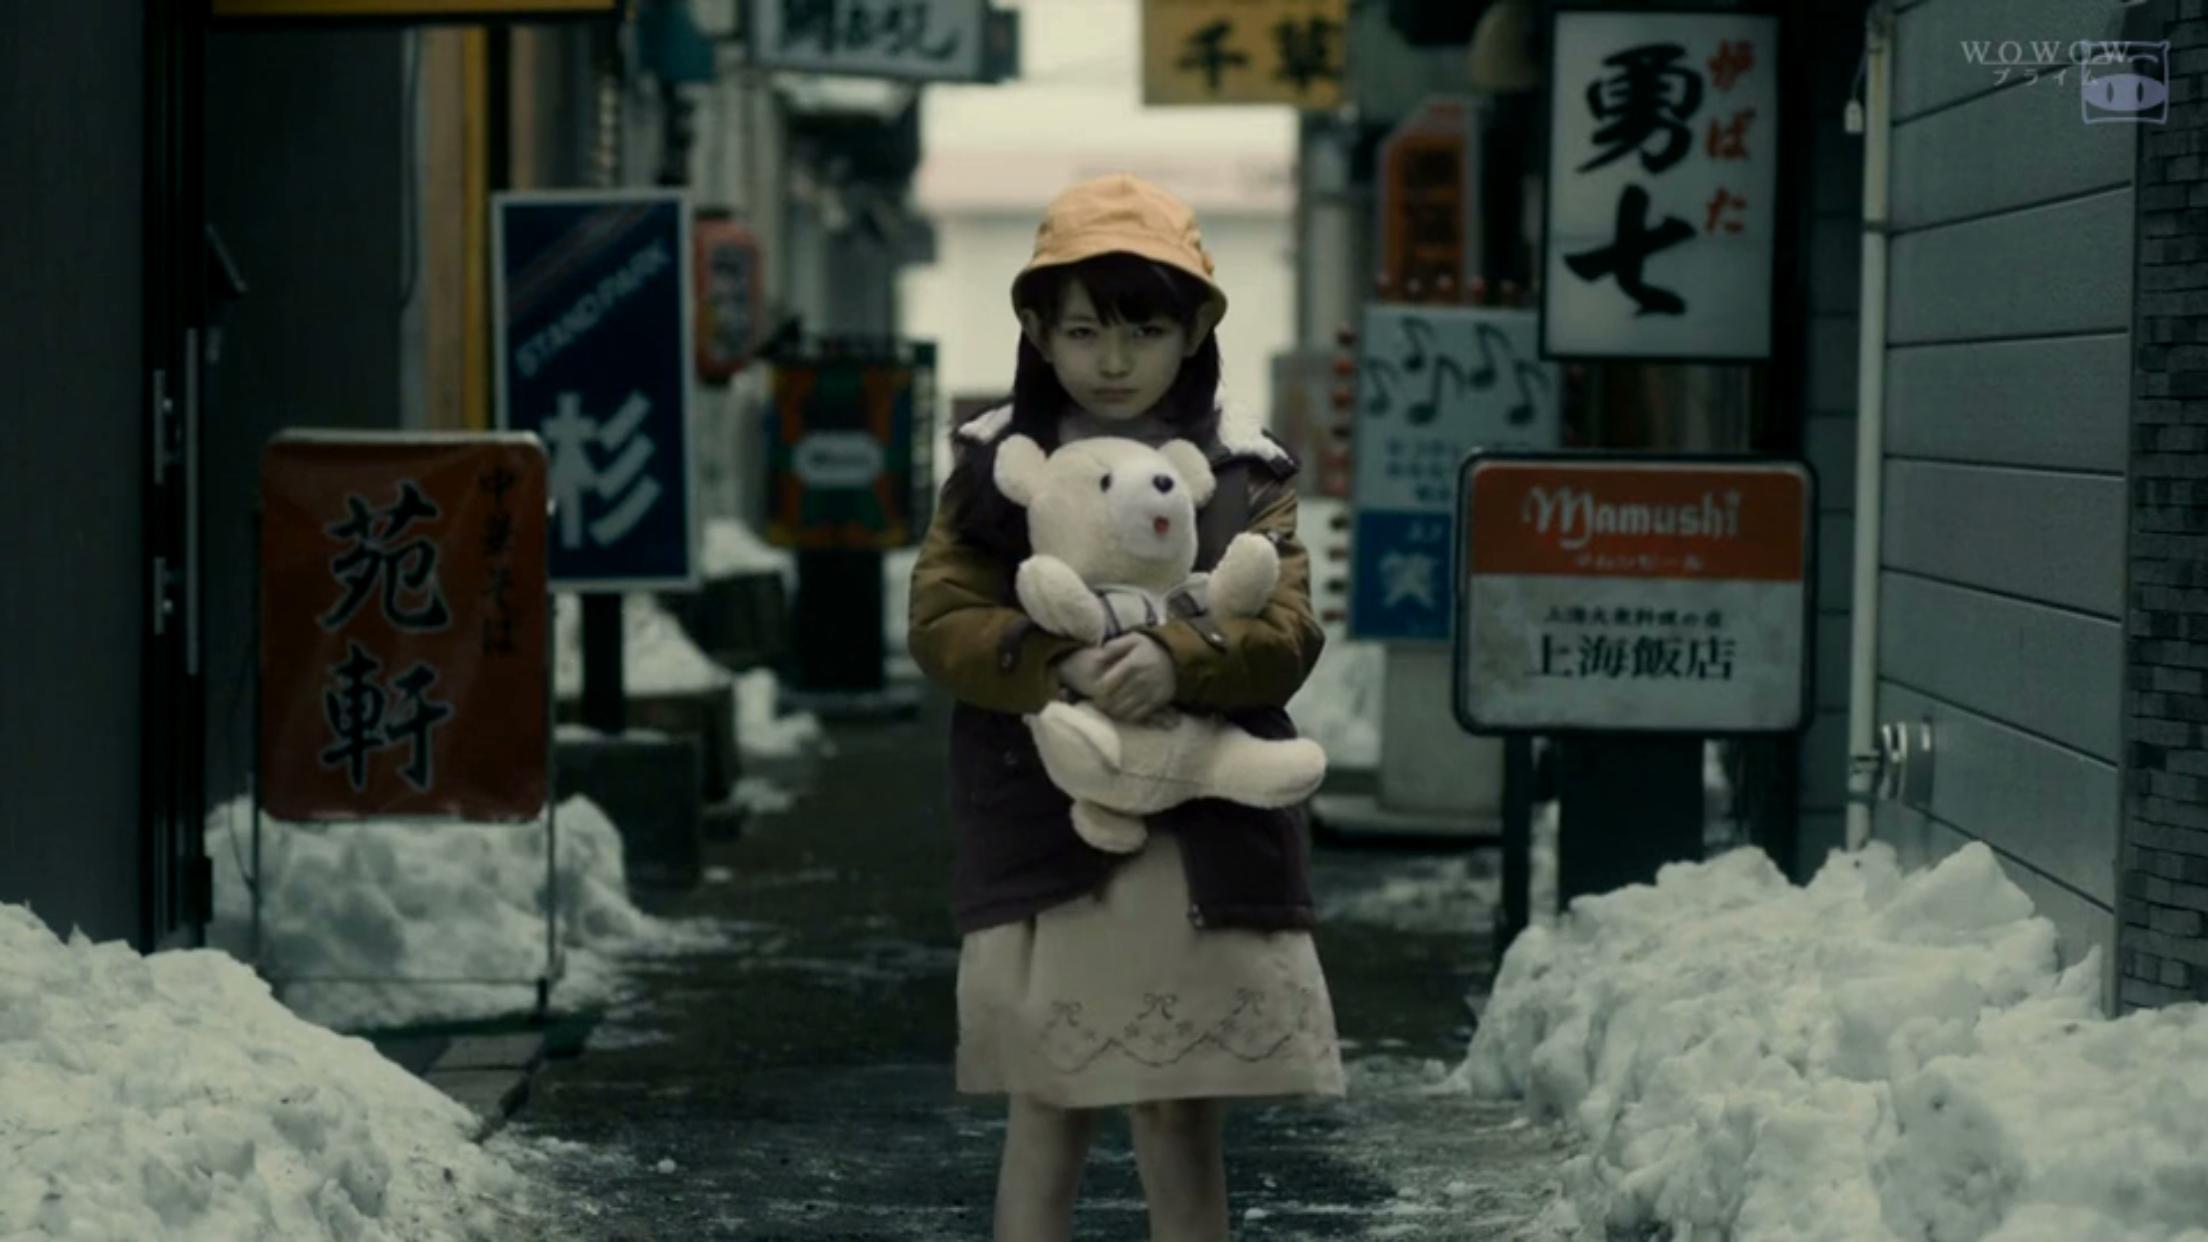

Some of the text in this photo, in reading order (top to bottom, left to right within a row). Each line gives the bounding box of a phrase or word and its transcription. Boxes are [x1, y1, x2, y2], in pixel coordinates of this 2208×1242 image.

[1564, 43, 1703, 318] 勇七
[515, 292, 600, 379] STAND
[540, 389, 664, 552] 杉
[1522, 484, 1742, 549] Mamushi
[315, 480, 455, 794] 苑軒
[1522, 632, 1737, 680] 上海飯店
